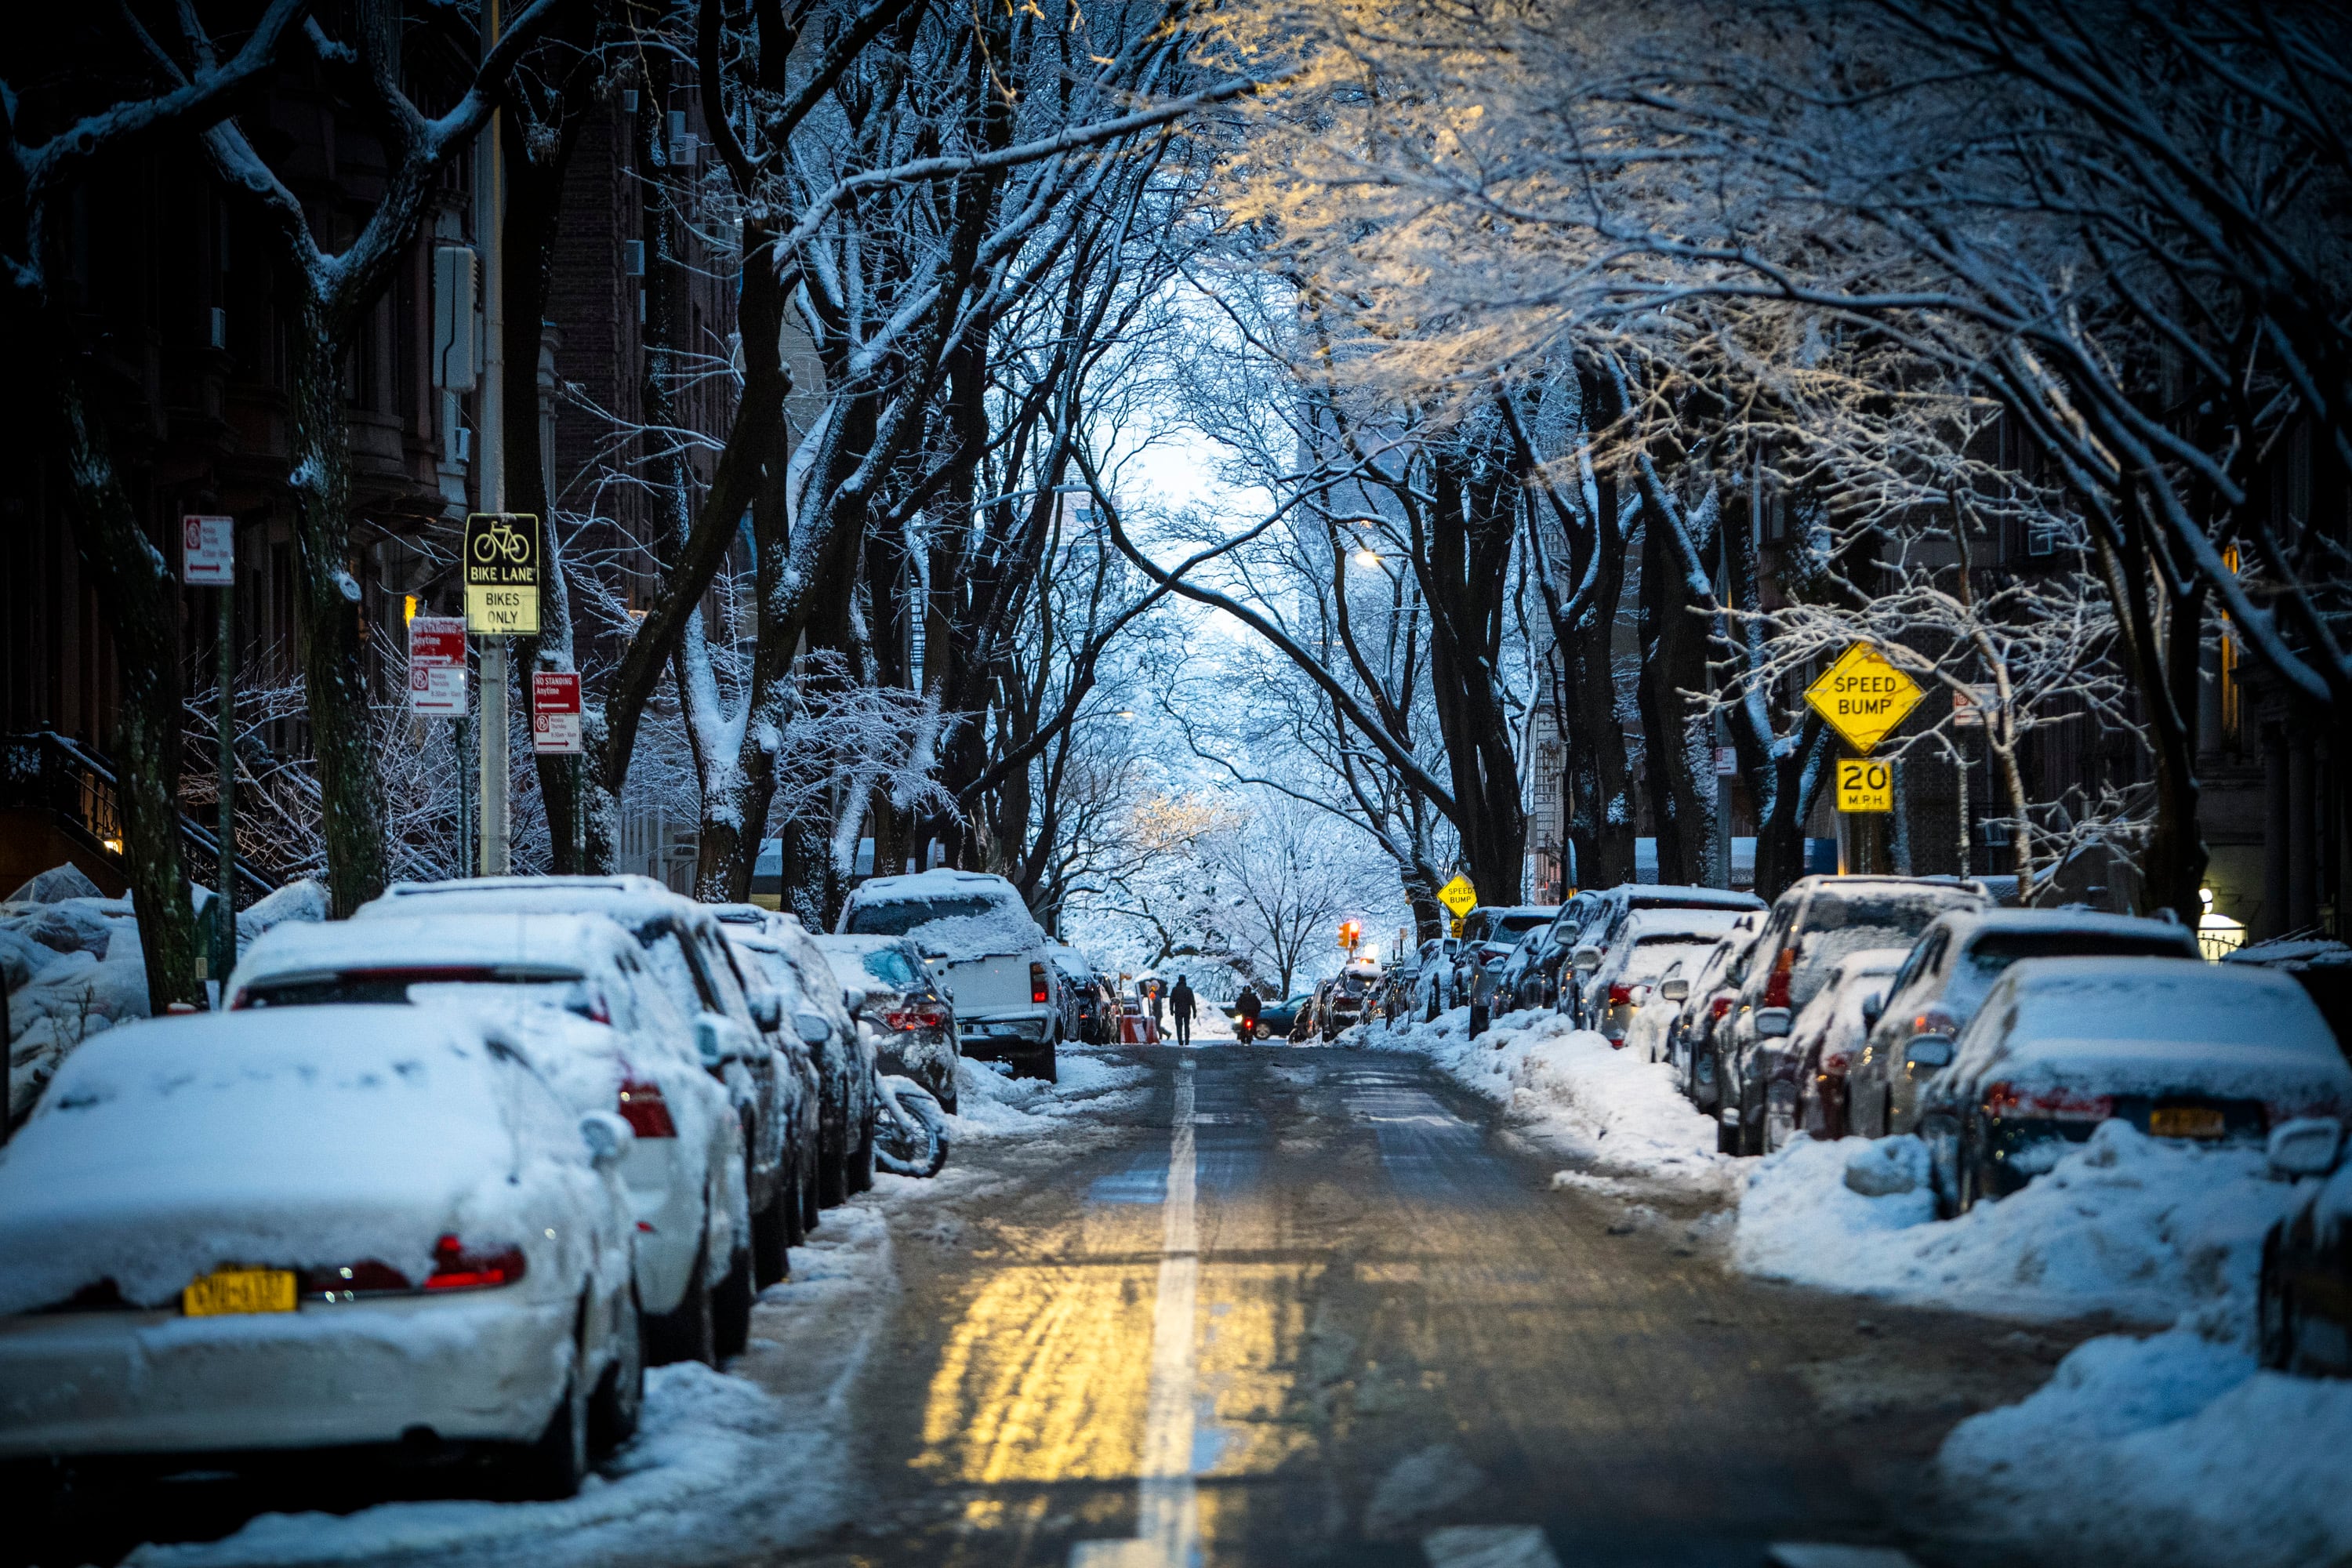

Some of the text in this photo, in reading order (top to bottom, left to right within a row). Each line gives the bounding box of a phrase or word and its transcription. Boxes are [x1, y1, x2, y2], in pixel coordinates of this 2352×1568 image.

[470, 566, 534, 582] BIKE LANE
[486, 593, 520, 606] BIKES
[488, 611, 518, 624] ONLY
[424, 624, 457, 634] STANDING
[412, 636, 441, 646] Anytime
[545, 677, 573, 685] STANDING
[1834, 676, 1896, 692] SPEED
[536, 687, 560, 696] Anytime
[1838, 699, 1893, 715] BUMP
[1843, 765, 1887, 790] 20
